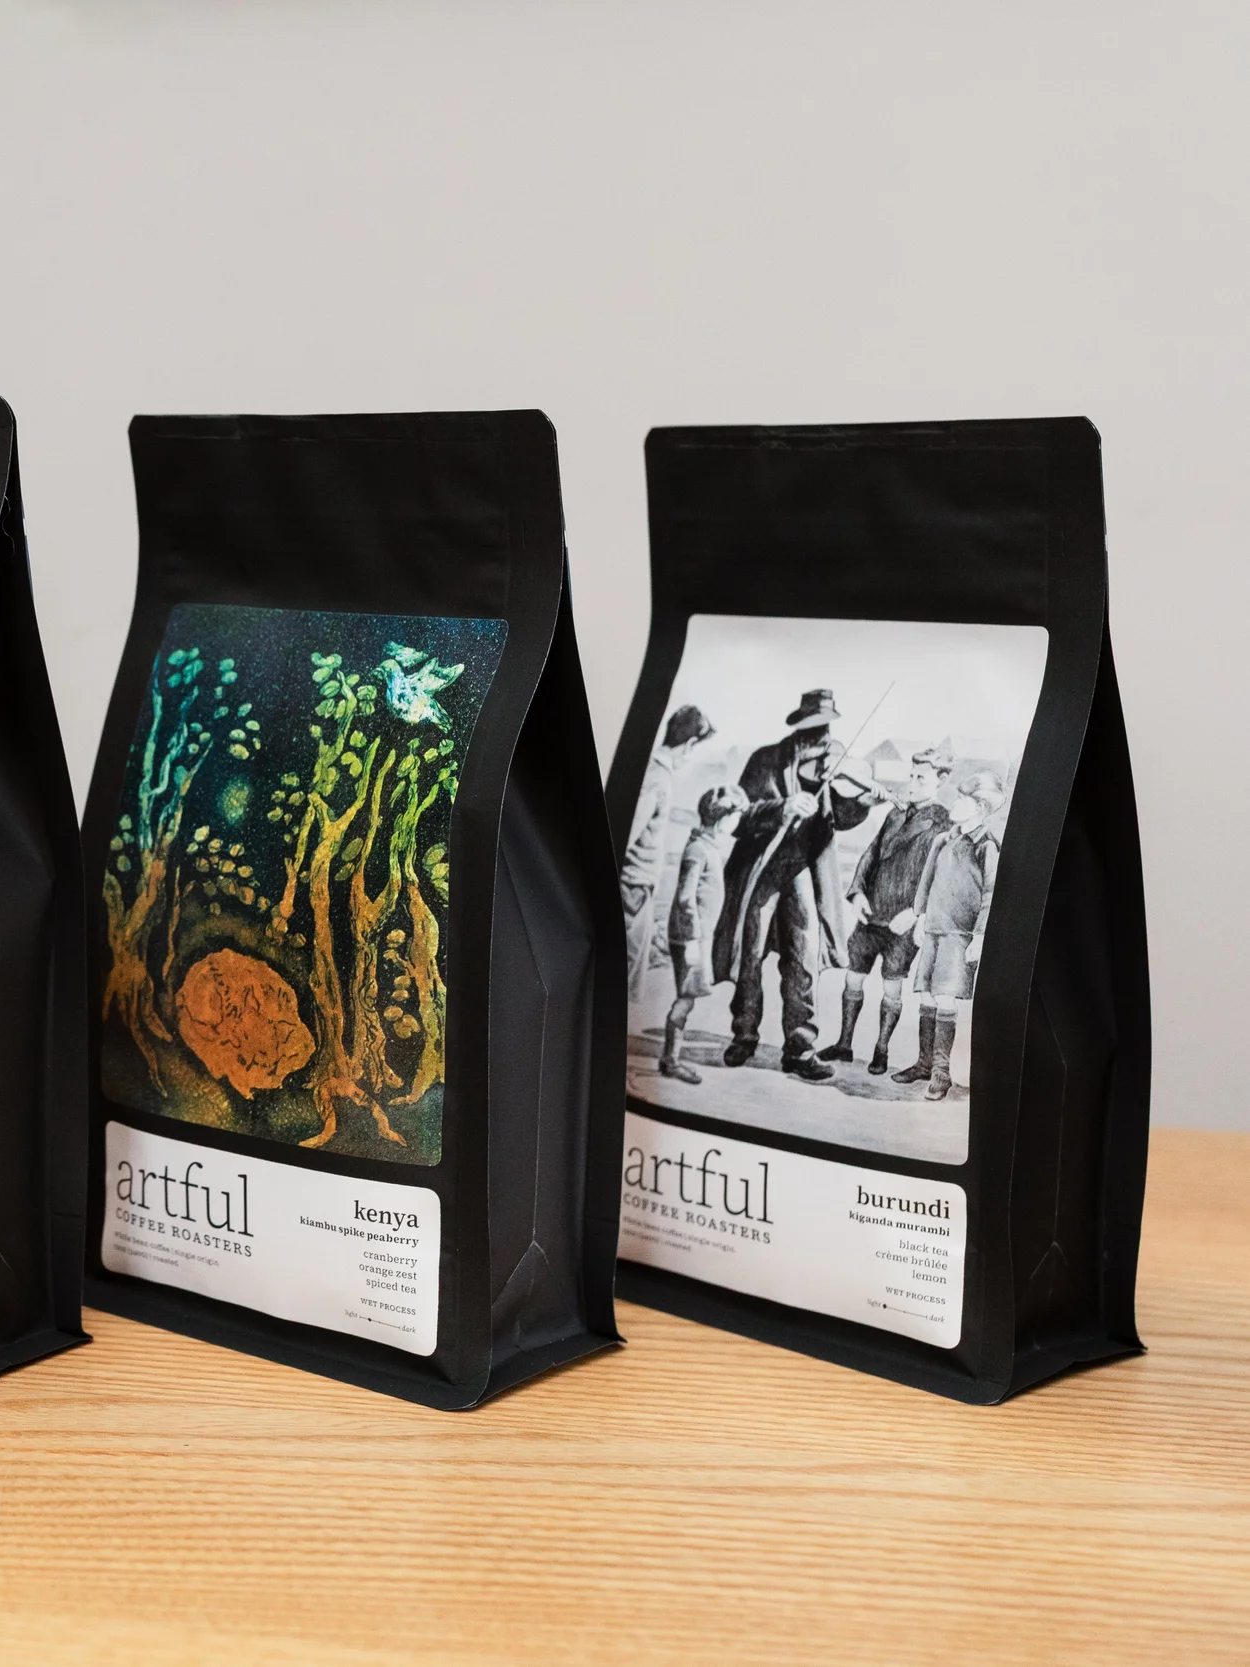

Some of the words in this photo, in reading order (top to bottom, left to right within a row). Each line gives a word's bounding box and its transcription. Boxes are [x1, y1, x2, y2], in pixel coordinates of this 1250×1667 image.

[624, 1147, 774, 1225] artful
[117, 1160, 254, 1238] artful
[856, 1185, 951, 1220] burundi
[354, 1200, 420, 1231] kenya
[623, 1193, 679, 1220] COFFEE
[686, 1211, 771, 1245] ROASTERS
[849, 1210, 893, 1227] kiganda
[896, 1221, 950, 1237] murambi
[115, 1207, 166, 1234] COFFEE
[171, 1226, 252, 1257] ROASTERS
[300, 1215, 337, 1232] kiambu
[338, 1226, 365, 1238] spike
[367, 1231, 419, 1248] peaberry
[363, 1250, 418, 1269] cranberry
[875, 1249, 909, 1264] crème
[899, 1240, 930, 1254] black
[932, 1247, 949, 1257] tea
[359, 1263, 394, 1278] orange
[395, 1270, 418, 1281] zest
[912, 1270, 947, 1285] lemon
[366, 1277, 398, 1292] spiced
[401, 1285, 417, 1295] tea
[885, 1286, 904, 1297] WET
[906, 1291, 946, 1305] PROCESS
[360, 1297, 378, 1308] WET
[379, 1302, 416, 1316] PROCESS
